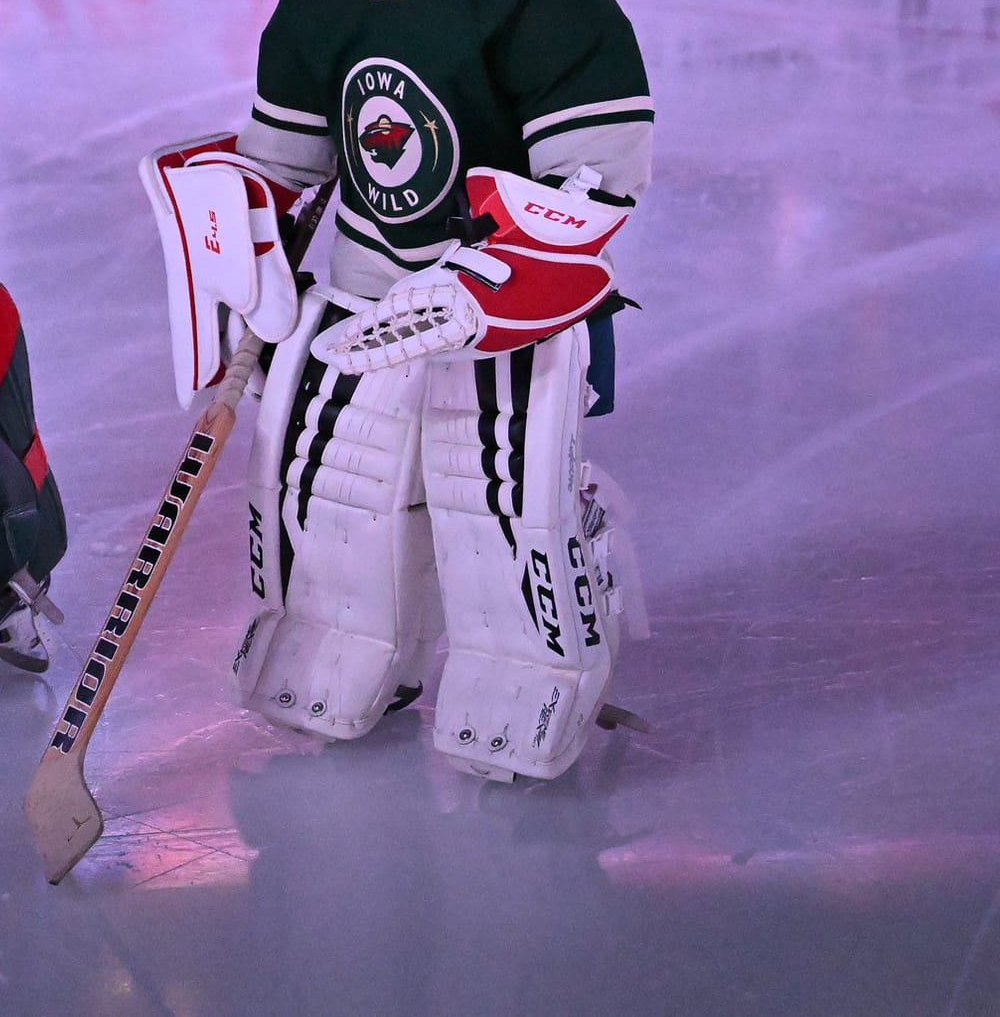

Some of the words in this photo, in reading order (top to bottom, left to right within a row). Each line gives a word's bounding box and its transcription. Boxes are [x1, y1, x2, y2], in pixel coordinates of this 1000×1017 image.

[357, 70, 406, 100] IOWA
[367, 182, 420, 212] WILD
[524, 201, 588, 230] CCM
[50, 430, 217, 755] WARRIOR
[248, 501, 266, 600] CCM
[566, 535, 601, 648] CCM
[530, 548, 565, 658] CCM
